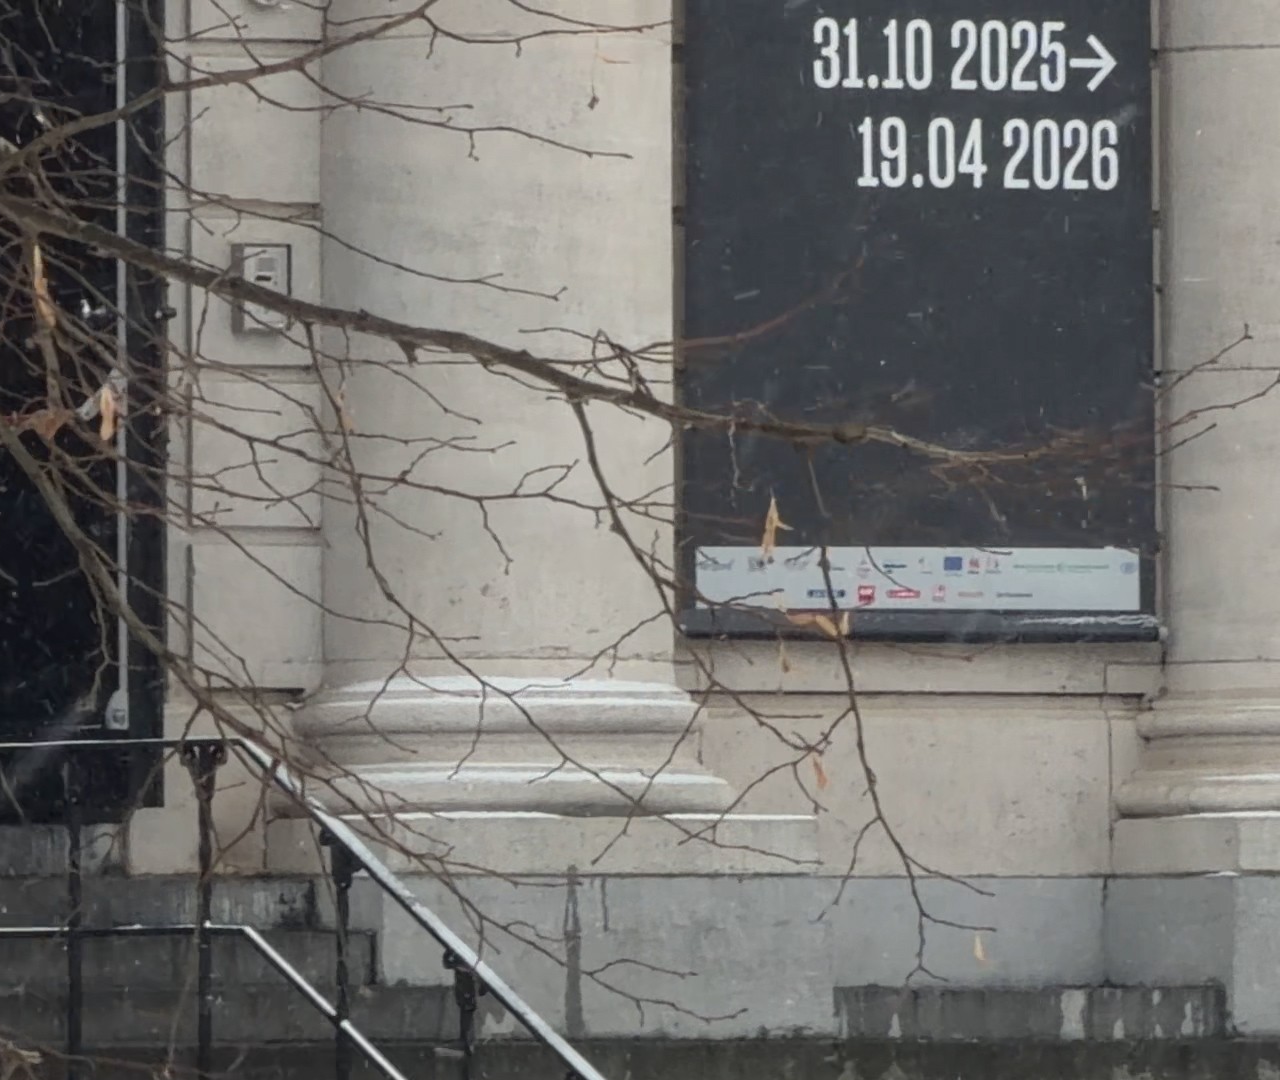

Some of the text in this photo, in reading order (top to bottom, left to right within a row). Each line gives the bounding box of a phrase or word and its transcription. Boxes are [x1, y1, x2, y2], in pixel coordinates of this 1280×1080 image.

[813, 17, 1067, 92] 31.10 2025
[857, 116, 1120, 191] 19.04 2026
